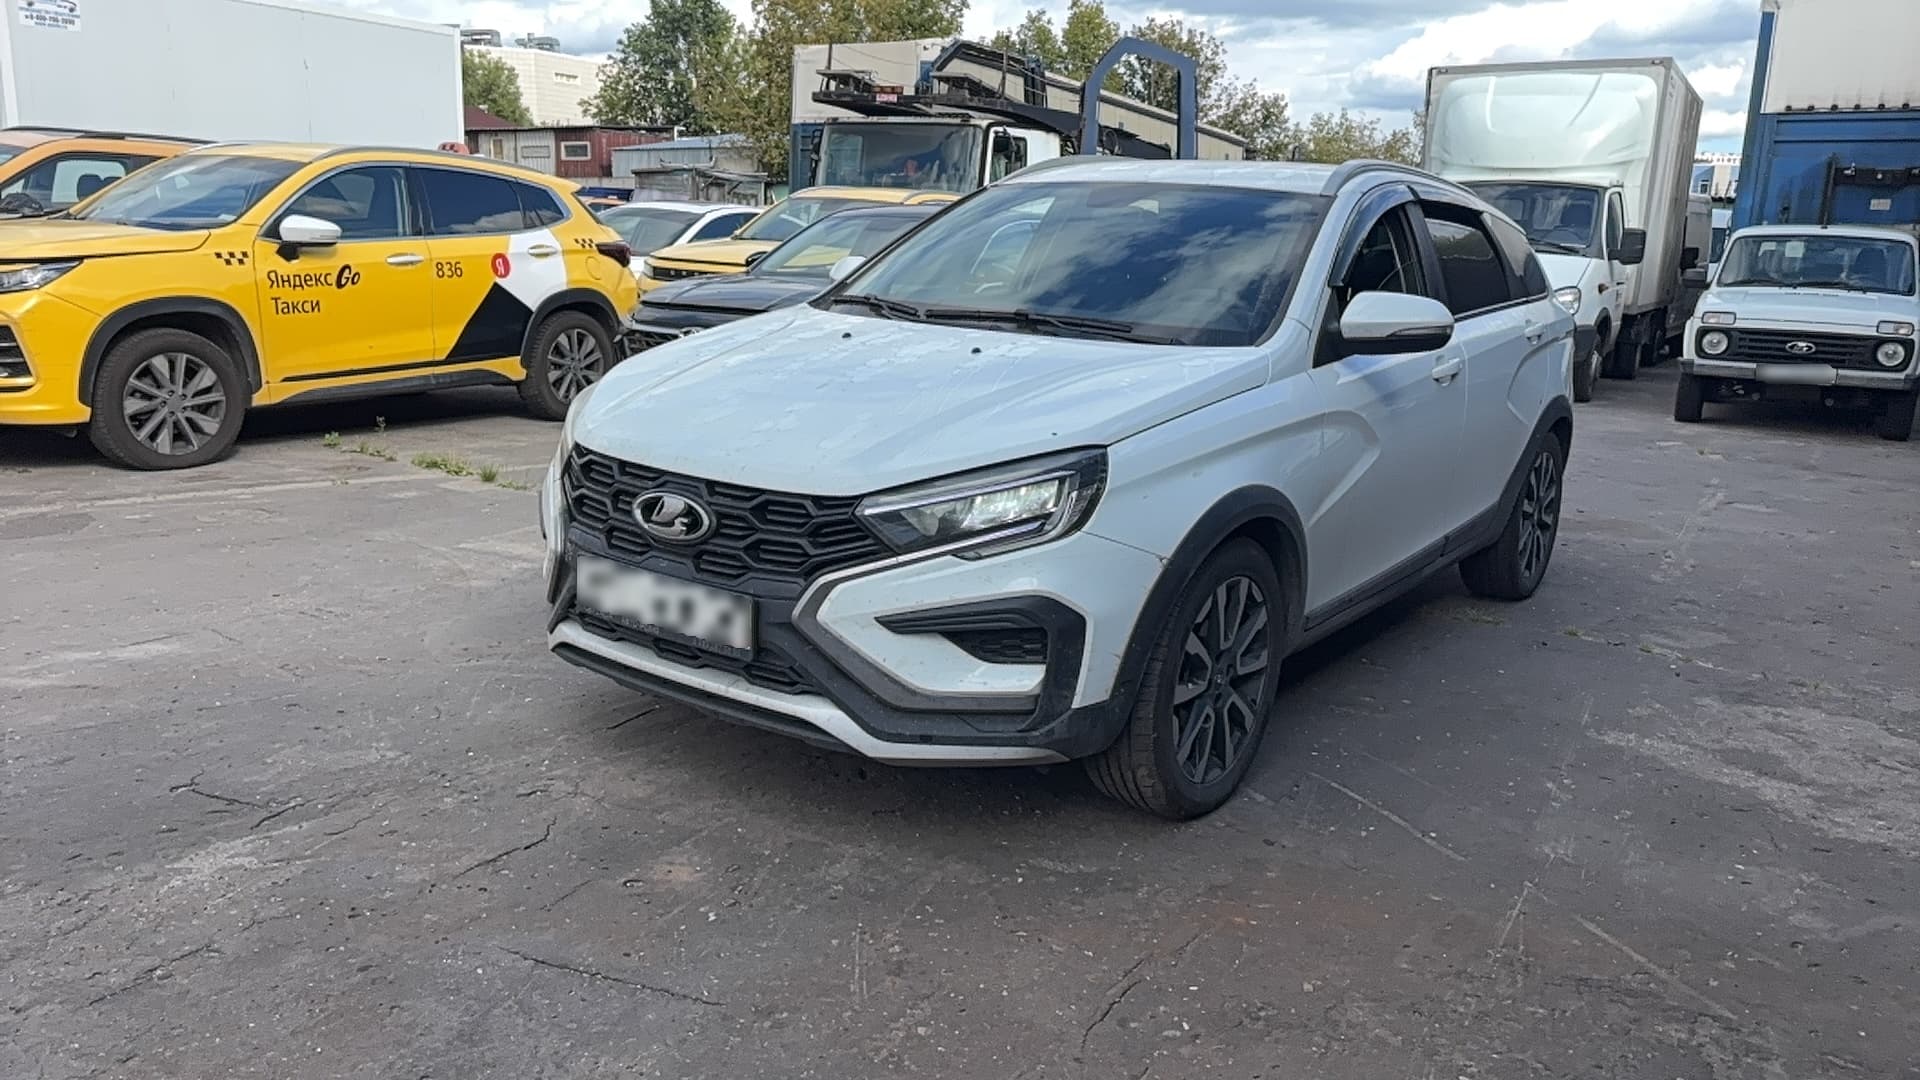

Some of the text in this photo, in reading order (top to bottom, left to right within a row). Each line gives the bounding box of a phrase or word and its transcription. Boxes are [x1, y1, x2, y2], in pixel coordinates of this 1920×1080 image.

[267, 264, 361, 290] Яндекс Go
[436, 262, 463, 279] 836
[271, 297, 321, 316] Такси
